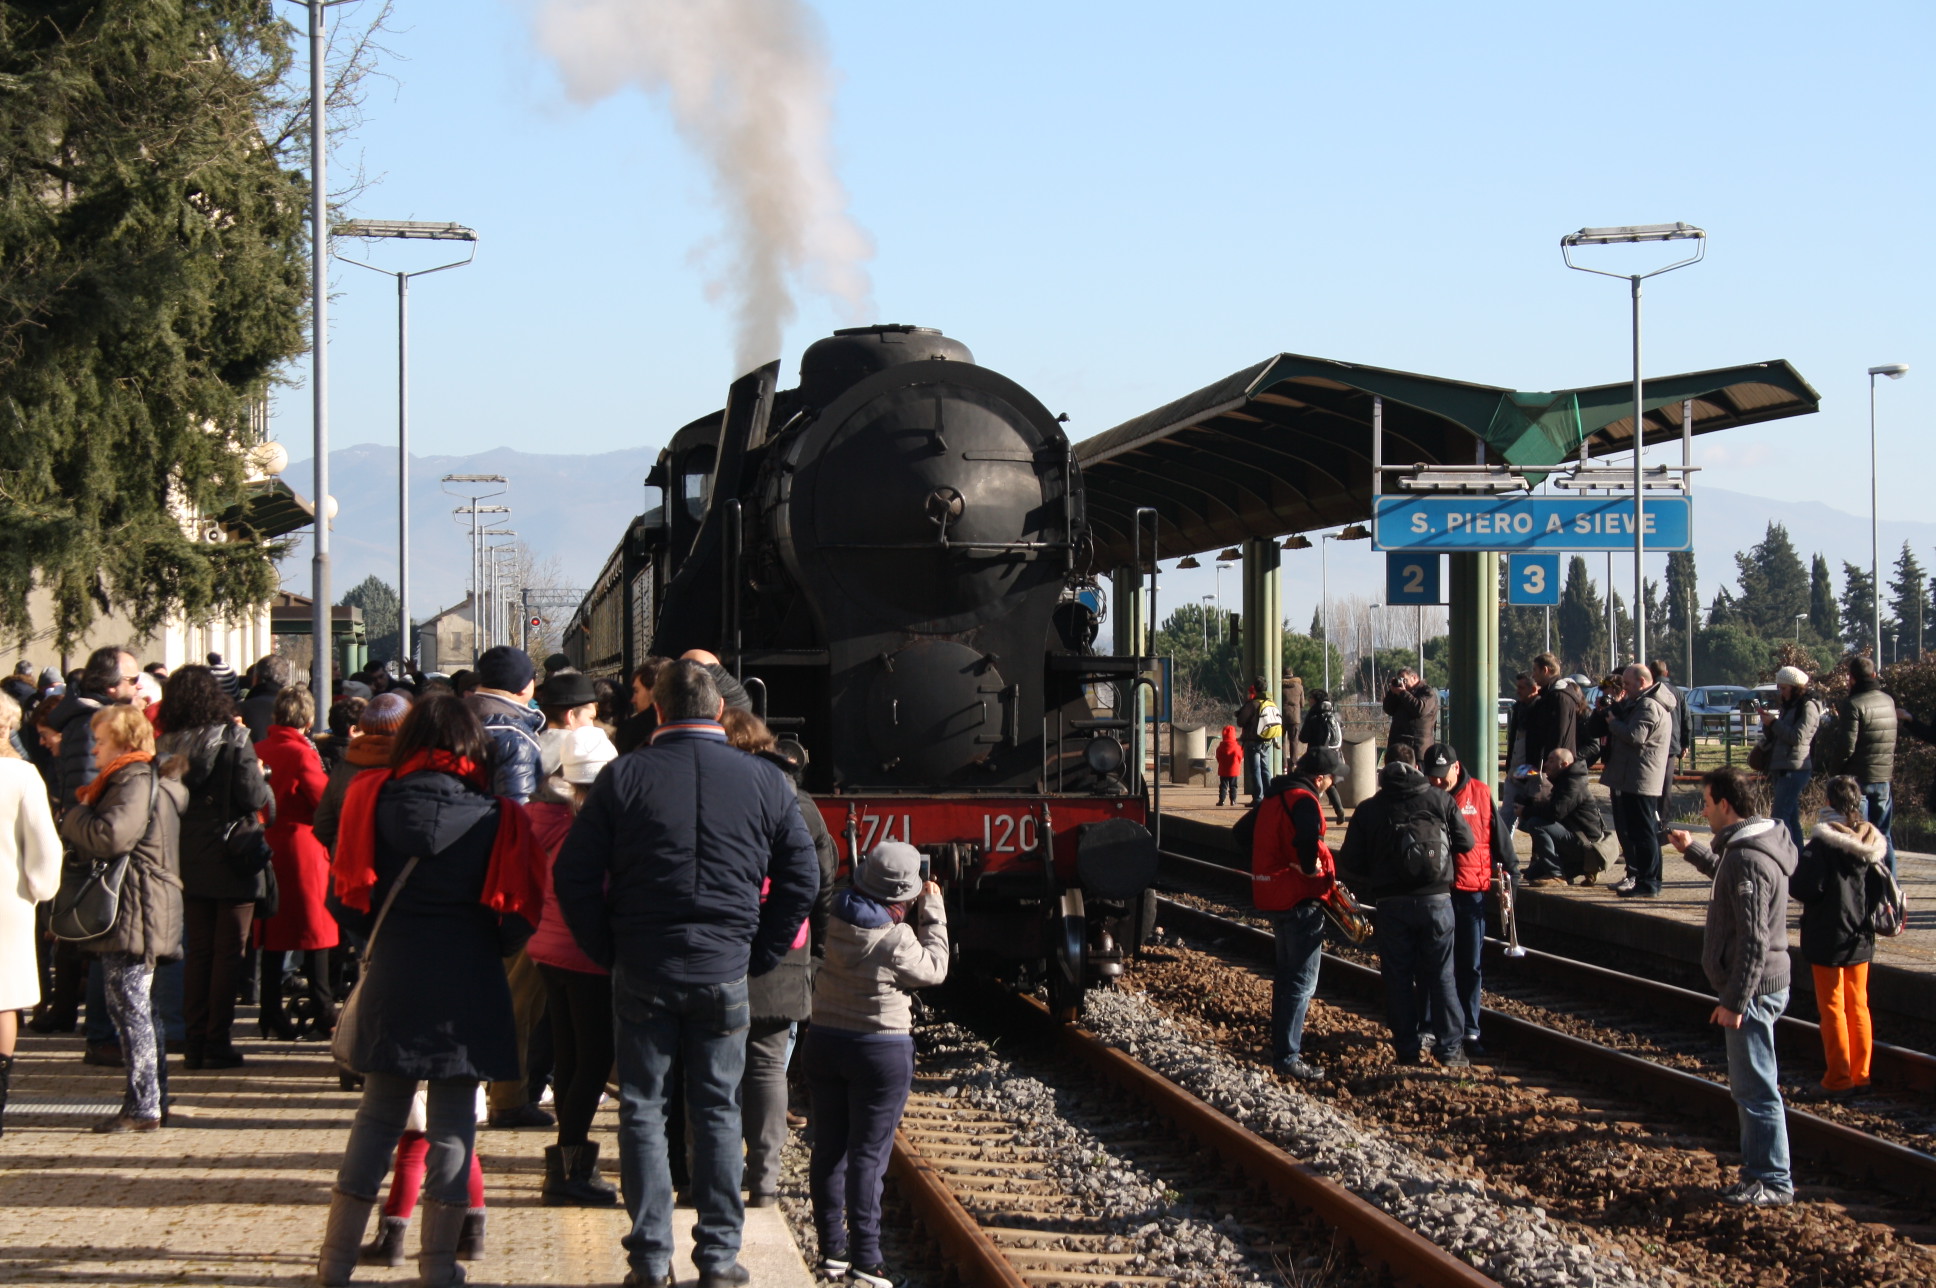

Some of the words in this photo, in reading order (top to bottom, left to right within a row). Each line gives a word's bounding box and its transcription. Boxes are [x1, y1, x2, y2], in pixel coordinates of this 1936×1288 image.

[1410, 512, 1436, 534] S.
[1447, 512, 1533, 534] PIERO
[1545, 512, 1564, 534] A
[1573, 512, 1657, 534] SIEVE
[1402, 564, 1424, 593] 2
[1522, 564, 1546, 594] 3
[861, 814, 910, 852] 741
[983, 814, 1039, 852] 120
